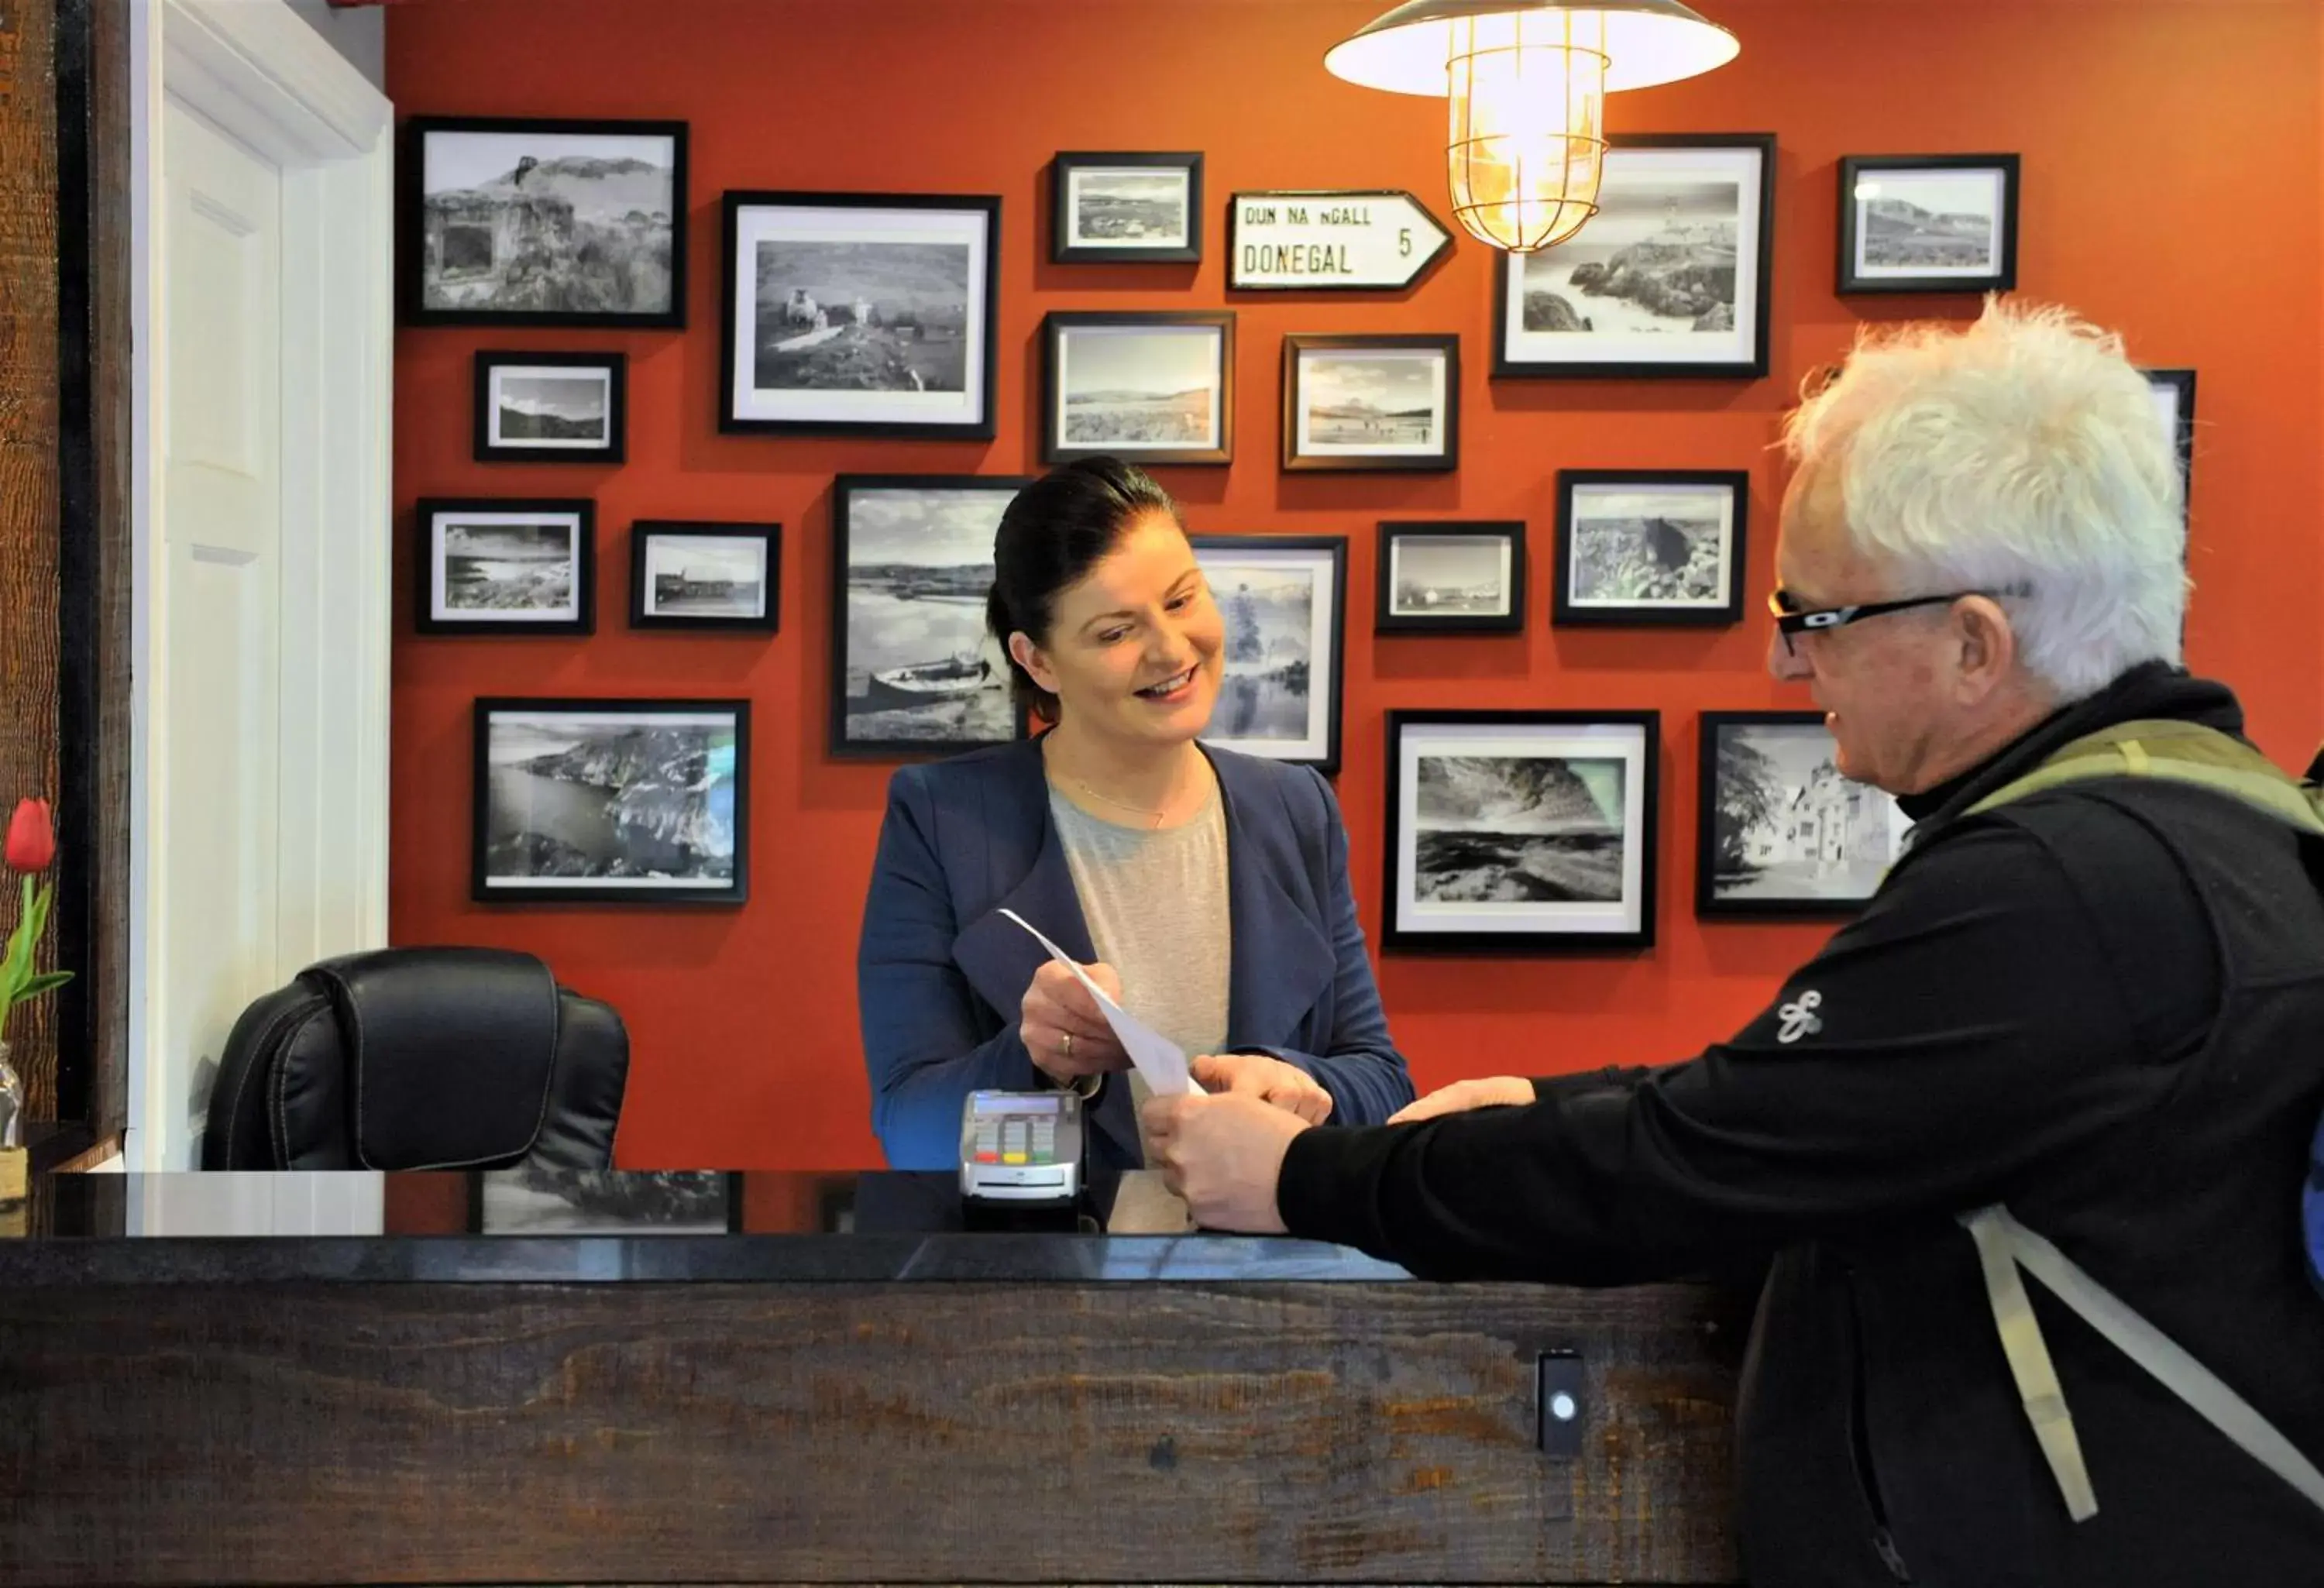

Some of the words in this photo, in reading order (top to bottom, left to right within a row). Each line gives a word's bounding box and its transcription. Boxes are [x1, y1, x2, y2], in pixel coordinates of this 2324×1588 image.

[1287, 206, 1308, 225] NA
[1399, 228, 1412, 257] 5
[1244, 244, 1353, 273] DONEGAL
